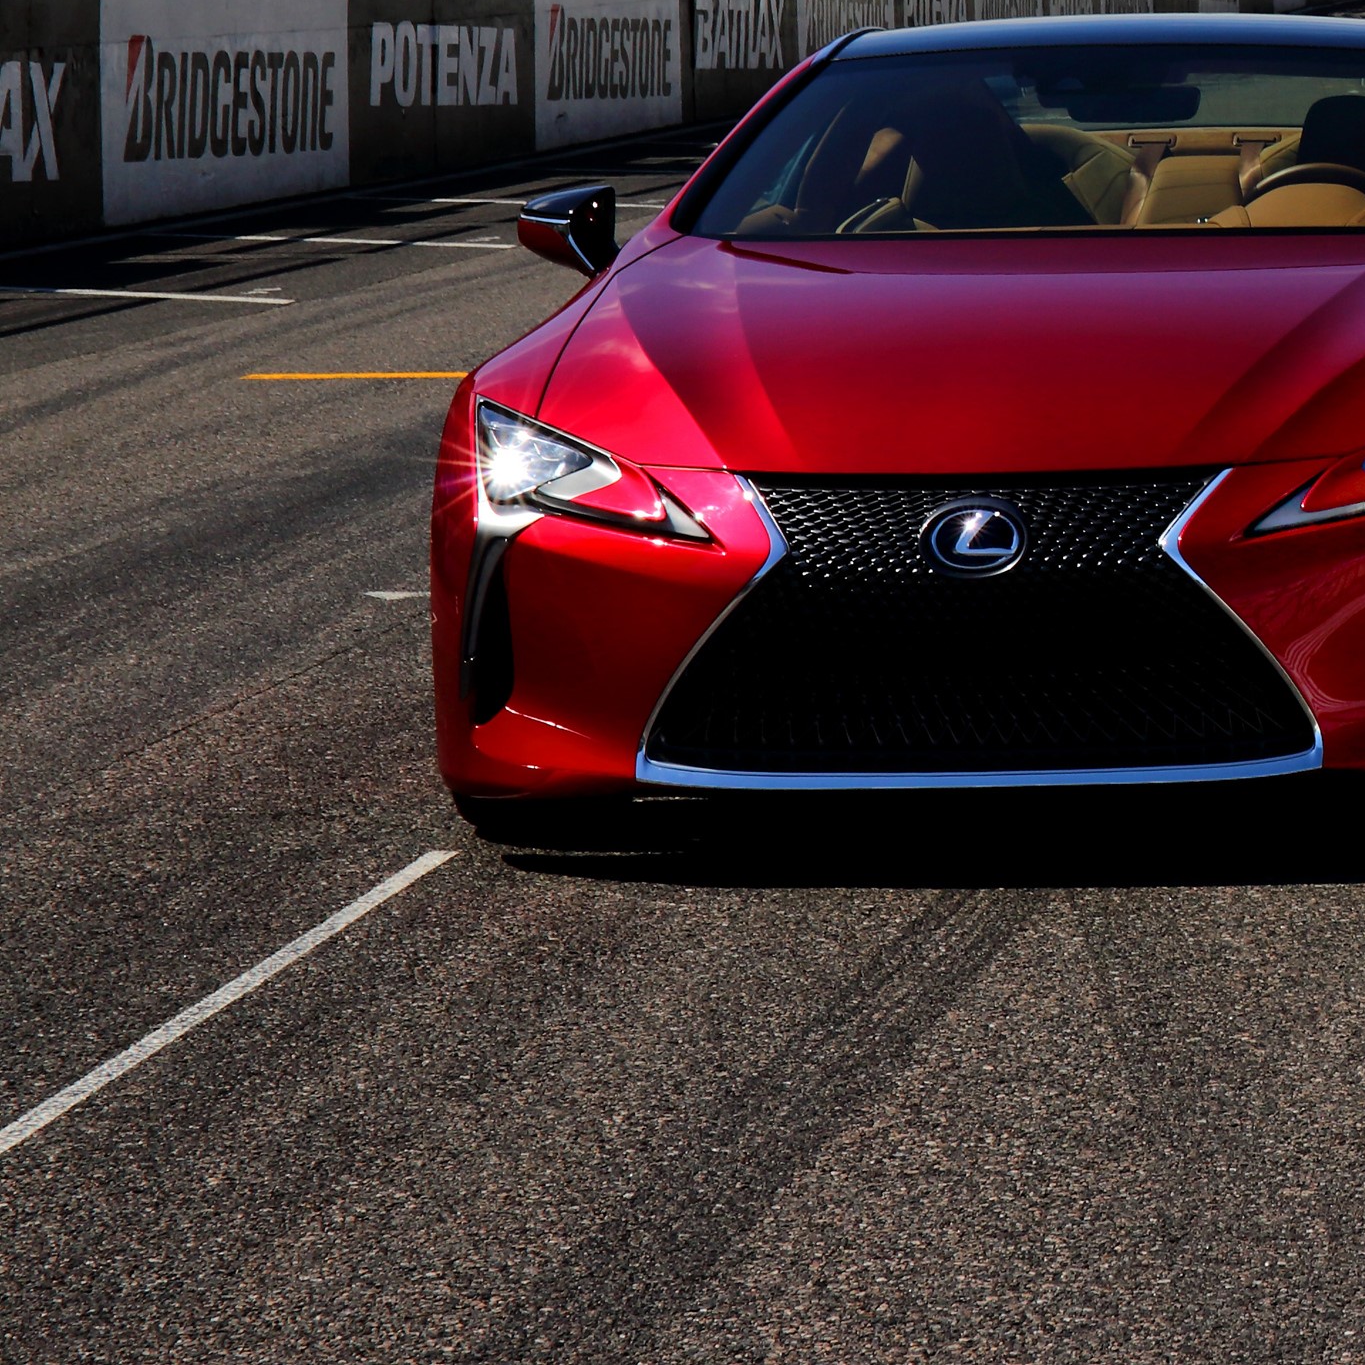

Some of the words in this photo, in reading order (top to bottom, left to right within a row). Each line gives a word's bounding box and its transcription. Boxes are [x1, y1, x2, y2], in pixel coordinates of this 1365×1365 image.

[123, 35, 334, 163] BRIDGESTONE
[370, 21, 518, 107] POTENZA
[547, 4, 673, 102] BRIDGESTONE
